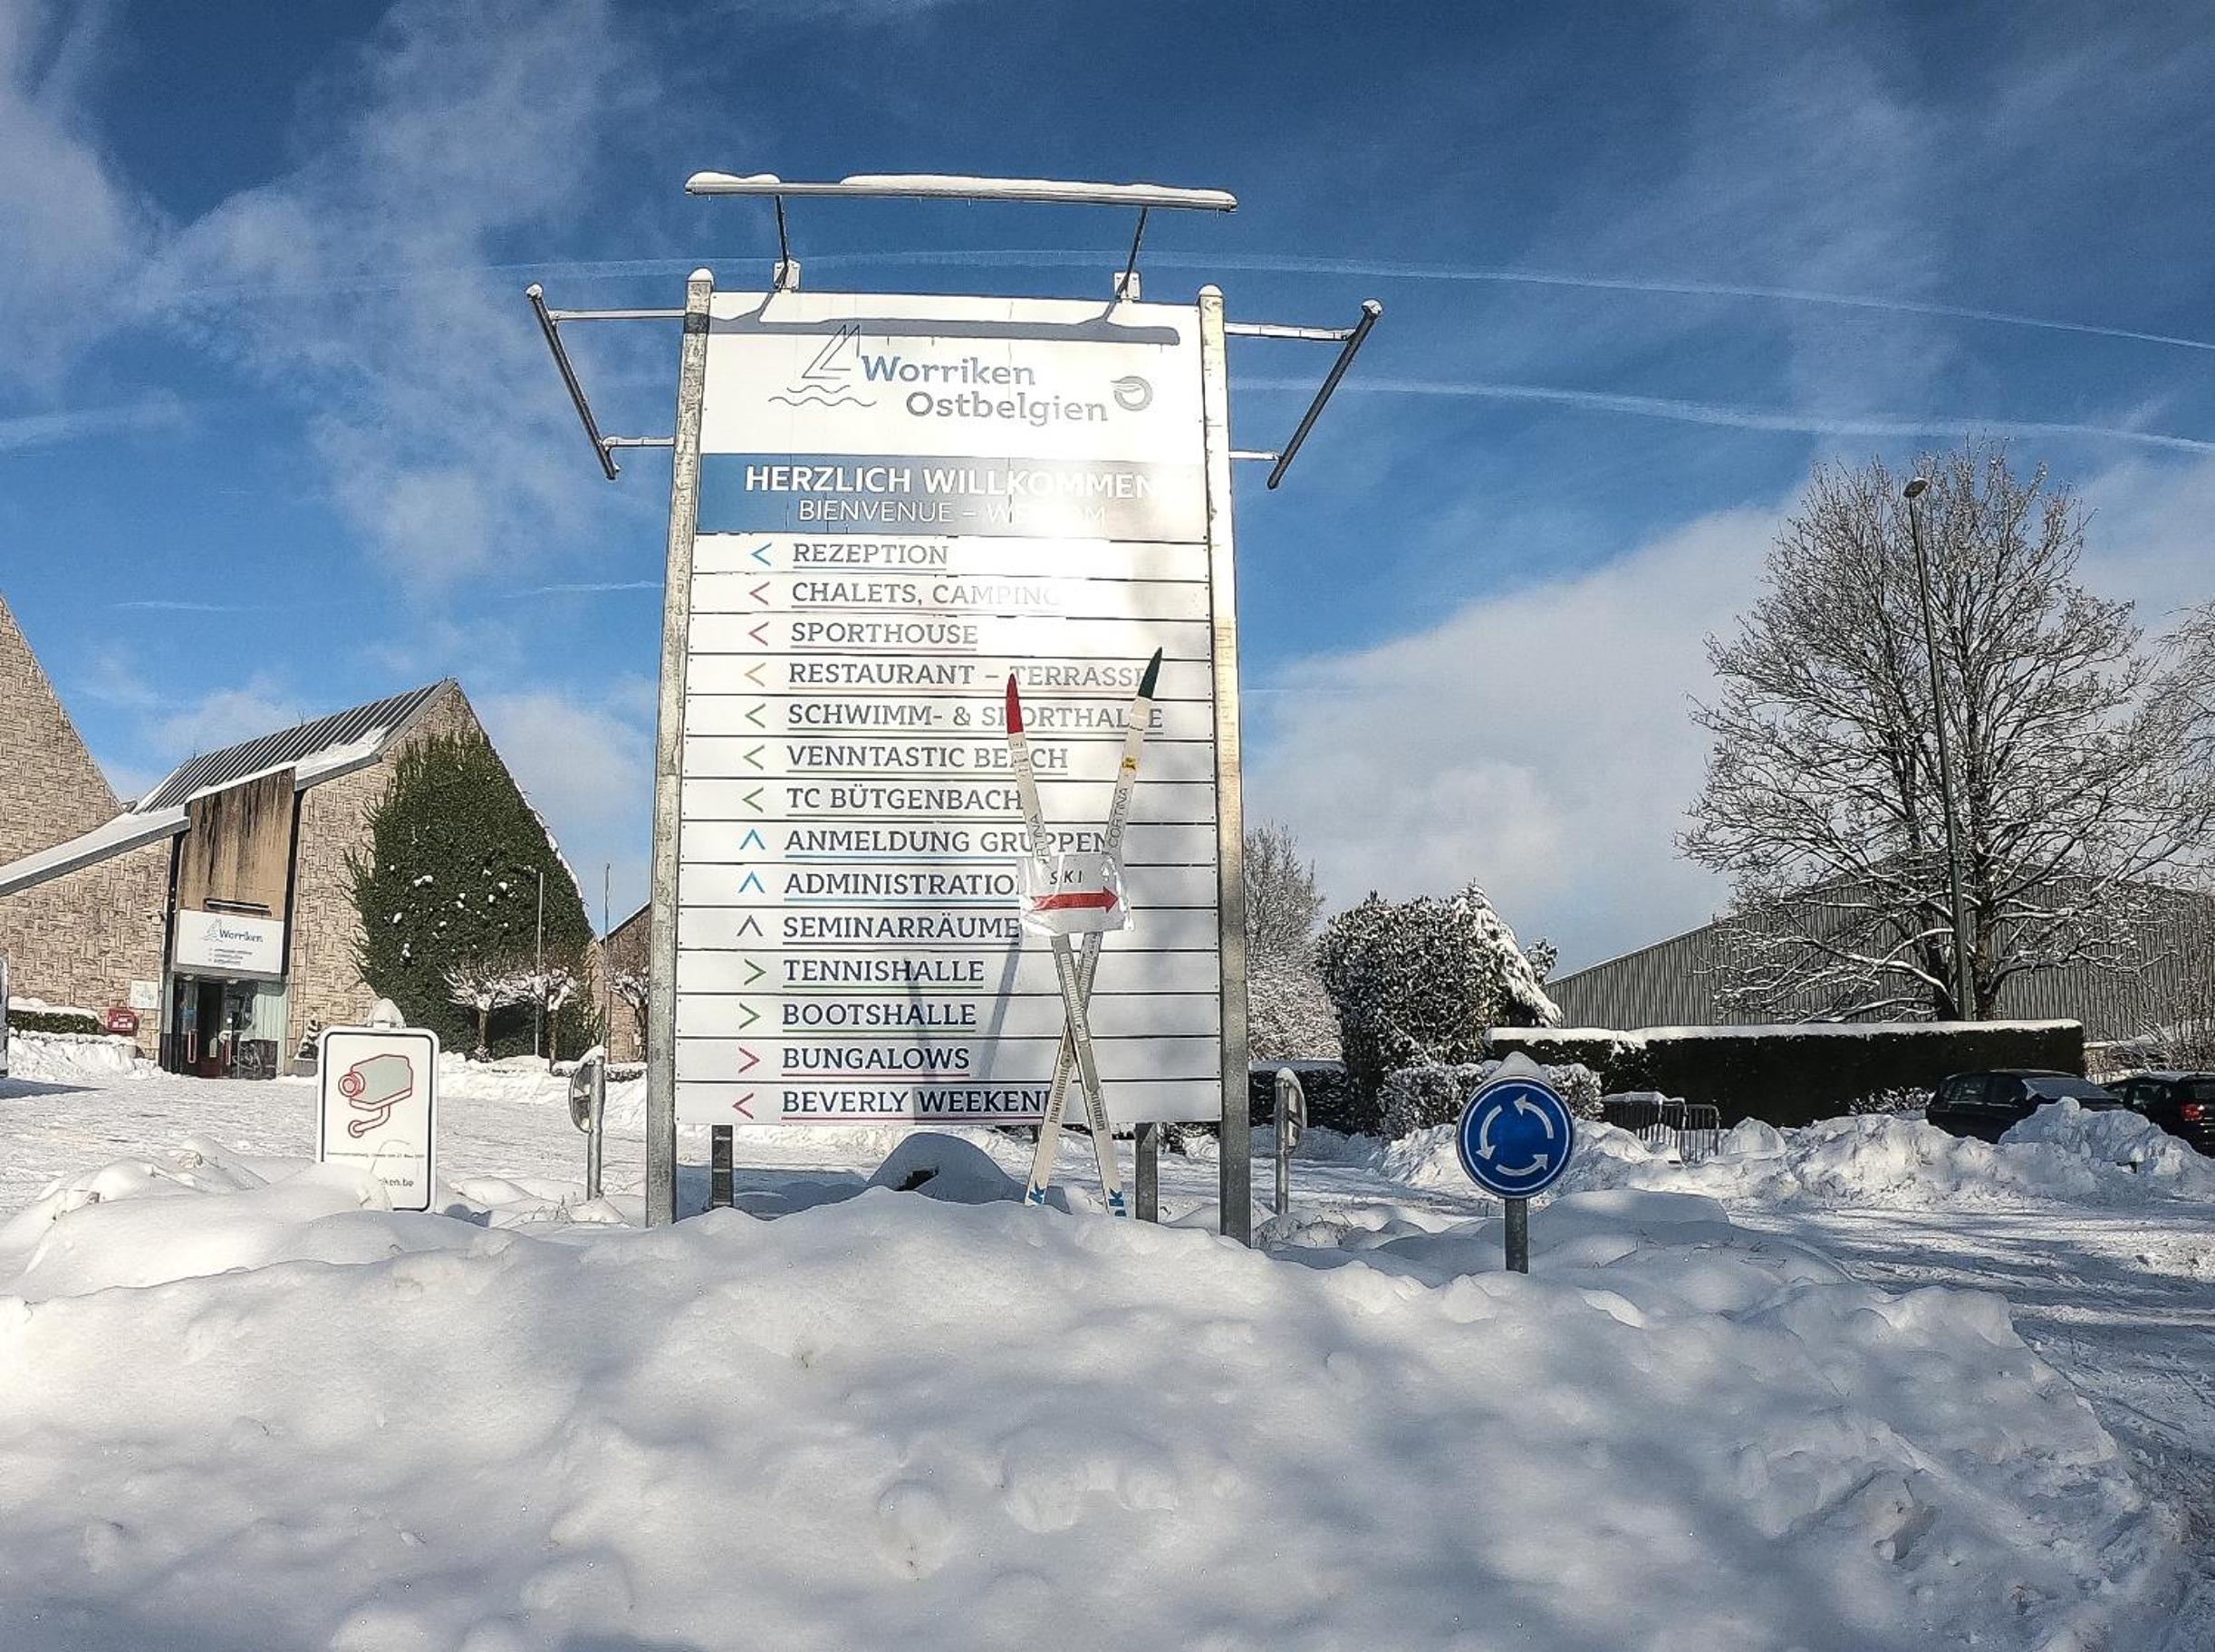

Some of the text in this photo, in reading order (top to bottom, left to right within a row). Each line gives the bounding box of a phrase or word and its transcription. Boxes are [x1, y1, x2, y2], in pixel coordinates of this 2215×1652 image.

[862, 354, 1035, 386] Worriken
[906, 391, 1108, 427] Ostbelgien
[745, 466, 1159, 499] HERZLICH WILLKOMMEN
[799, 500, 950, 523] BIENVENUE
[793, 544, 949, 566] REZEPTION
[792, 582, 922, 607] CHALETS,
[791, 622, 978, 646] SPORTHOUSE
[789, 662, 975, 686] RESTAURANT
[787, 703, 1162, 729] SCHWIMM- & SORTHALE
[787, 745, 966, 769] VENNTASTIC
[974, 747, 1068, 770] BECH
[786, 783, 1023, 812] TC BÜTGENBACH
[784, 830, 970, 853] ANMELDUNG
[784, 873, 1019, 897] ADMINISTRATIO
[1049, 869, 1083, 886] SKI
[782, 911, 1021, 939] SEMINARRÄUME
[784, 959, 985, 982] TENNISHALLE
[782, 1002, 977, 1026] BOOTSHALLE
[781, 1046, 970, 1071] BUNGALOWS
[781, 1090, 909, 1114] BEVERLY
[919, 1090, 1051, 1114] WEEKEN
